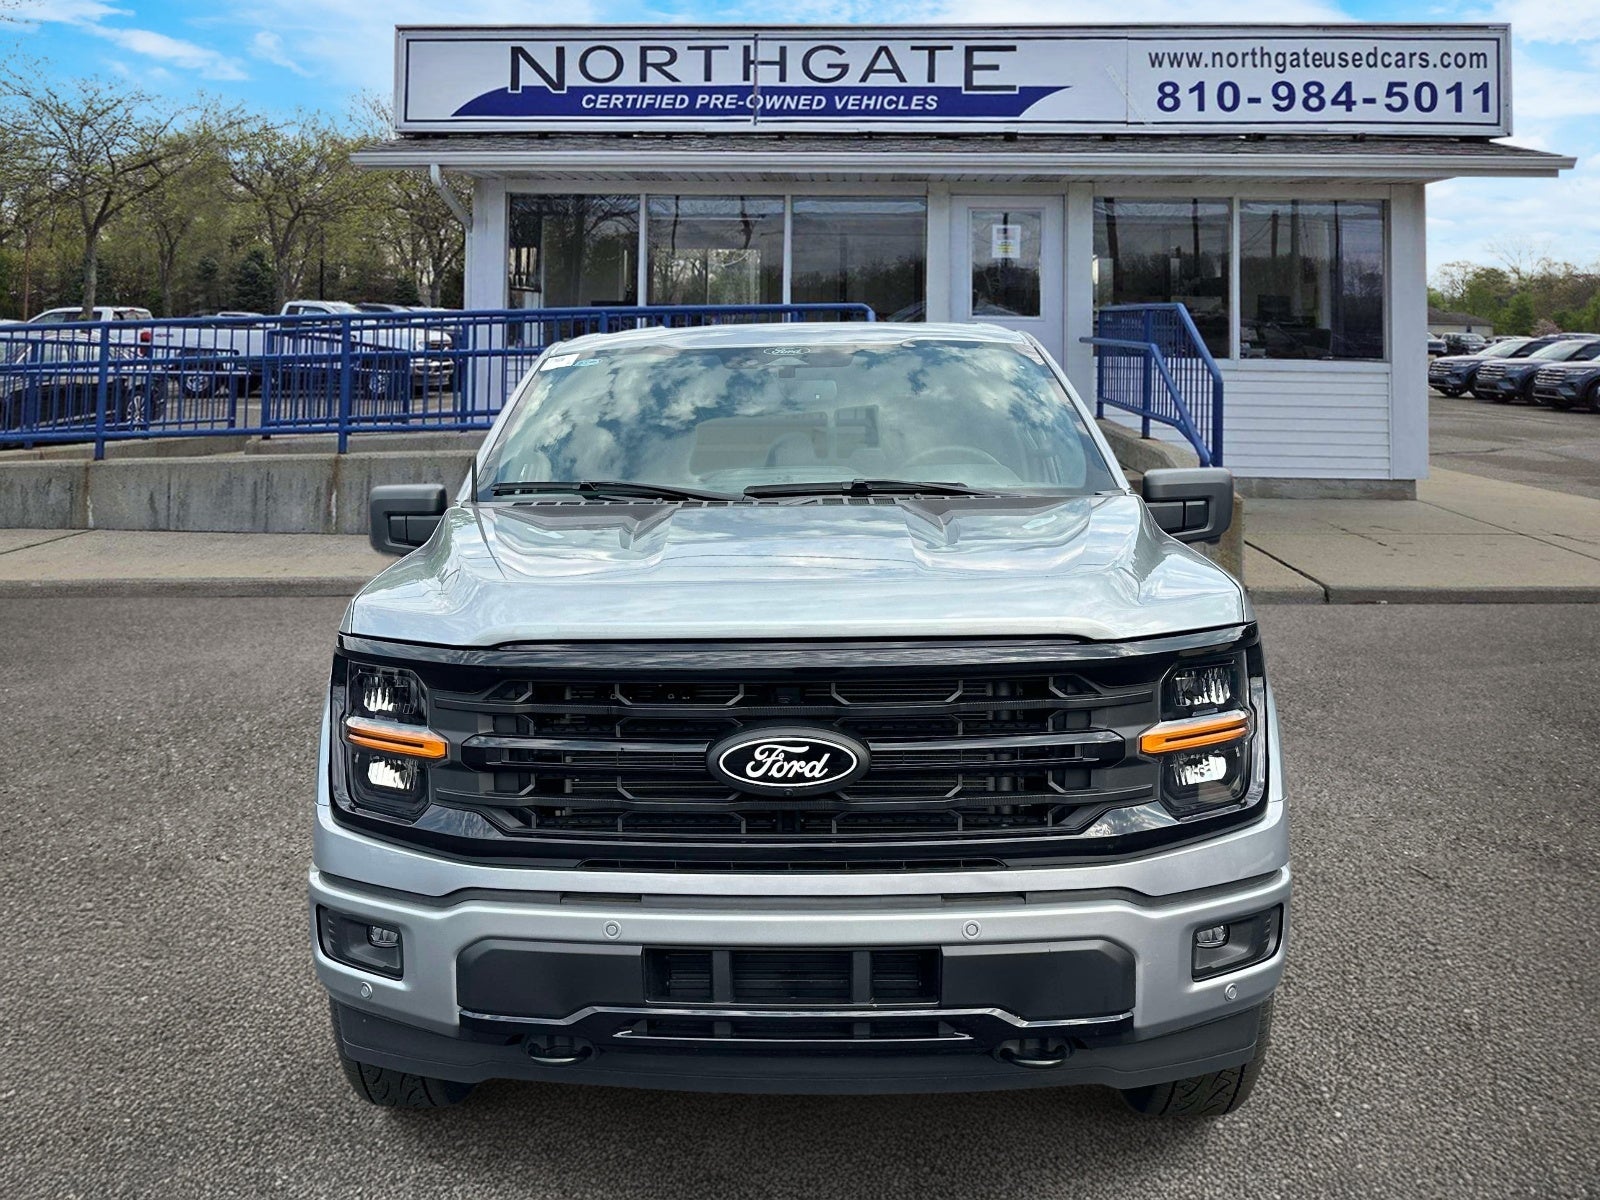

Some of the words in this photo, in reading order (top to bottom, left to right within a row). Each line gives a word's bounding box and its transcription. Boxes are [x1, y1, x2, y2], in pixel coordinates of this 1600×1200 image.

[509, 45, 1017, 92] NORTHGATE
[1148, 46, 1489, 73] www.northgateusedcars.com
[581, 94, 689, 109] CERTIFIED
[695, 94, 827, 110] PRE-OWNED
[834, 95, 939, 110] VEHICLES
[1156, 80, 1491, 113] 810-984-5011
[745, 744, 831, 778] Ford
